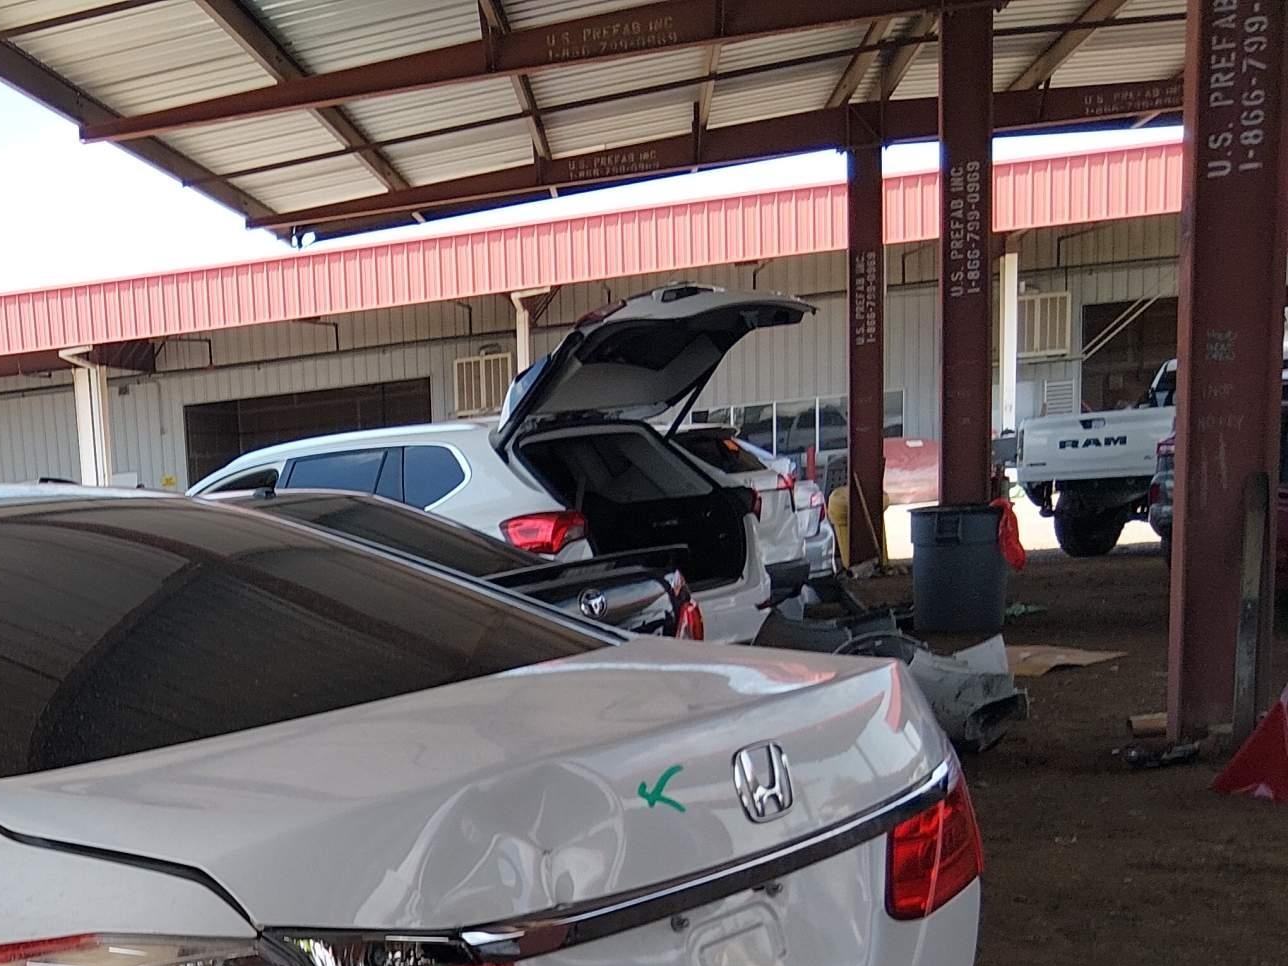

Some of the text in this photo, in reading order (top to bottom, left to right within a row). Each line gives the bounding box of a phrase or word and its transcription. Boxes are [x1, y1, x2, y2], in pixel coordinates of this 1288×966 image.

[1208, 122, 1233, 178] U.S.
[950, 199, 964, 260] PREFAB
[966, 161, 980, 293] 1-866-799-0969
[855, 278, 865, 319] PREFAB
[866, 251, 876, 343] 1-866-799-0969
[950, 266, 964, 297] U.S.
[1058, 435, 1127, 450] RAM
